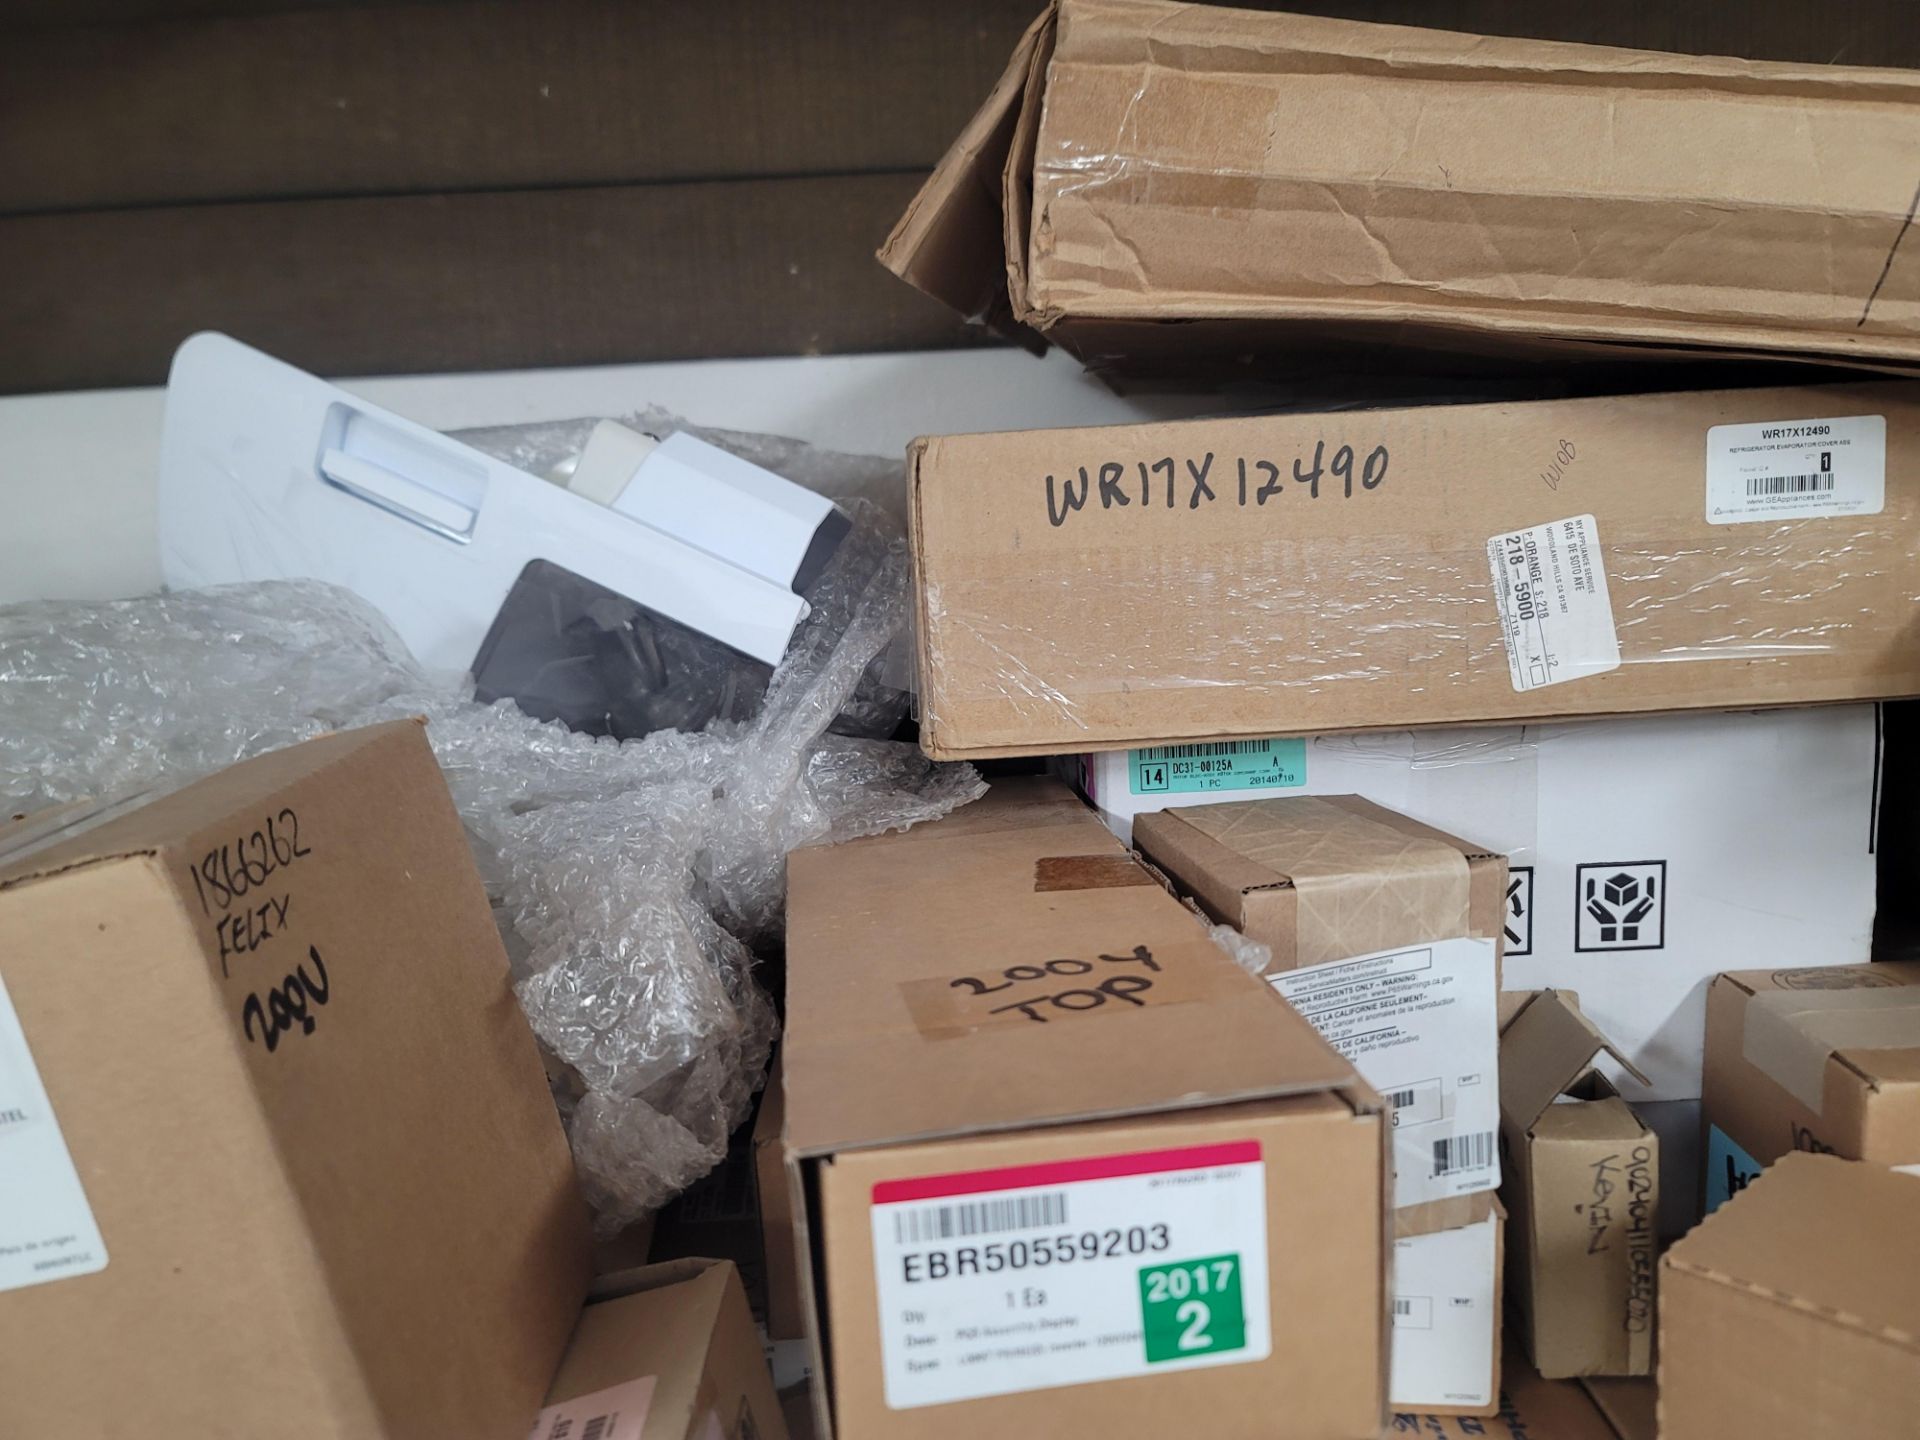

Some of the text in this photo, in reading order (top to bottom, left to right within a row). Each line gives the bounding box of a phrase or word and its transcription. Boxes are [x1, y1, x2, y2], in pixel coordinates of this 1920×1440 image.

[1762, 426, 1830, 439] WR17X12490
[1730, 444, 1776, 453] REFRIGERATOR
[1776, 441, 1817, 450] EVAPORATOR
[1818, 440, 1838, 448] COVER
[1822, 455, 1829, 469] 1
[1746, 493, 1832, 505] www.GEAppliances.com
[1546, 526, 1558, 564] WOODLAND
[1564, 522, 1584, 592] 6415 DE SOTO AVE
[1578, 531, 1590, 566] APPLIANCE
[1584, 566, 1596, 594] SERVICE
[1525, 541, 1543, 584] ORANGE
[1536, 600, 1550, 619] 218
[1552, 564, 1562, 586] HILLS
[1556, 586, 1564, 594] CA
[1172, 760, 1232, 774] DC31-00125A
[1272, 756, 1278, 768] A
[1145, 768, 1164, 785] 14
[1210, 779, 1221, 787] PC
[216, 894, 289, 979] FELIX
[1286, 975, 1316, 986] Instruction
[1317, 970, 1334, 979] Sheet
[988, 976, 1153, 1022] TOP
[1312, 987, 1354, 1000] RESIDENTS
[1354, 982, 1374, 993] ONLY
[1310, 1016, 1320, 1024] DE
[1323, 1014, 1333, 1022] LA
[1334, 1003, 1378, 1018] CALIFORNIE
[1332, 1018, 1356, 1028] Cancer
[1415, 998, 1456, 1010] reproduction
[1342, 1040, 1352, 1048] DE
[1354, 1030, 1400, 1046] CALIFORNIA
[902, 1223, 1172, 1284] EBR50559203
[1145, 1260, 1234, 1303] 2017
[1174, 1301, 1213, 1350] 2
